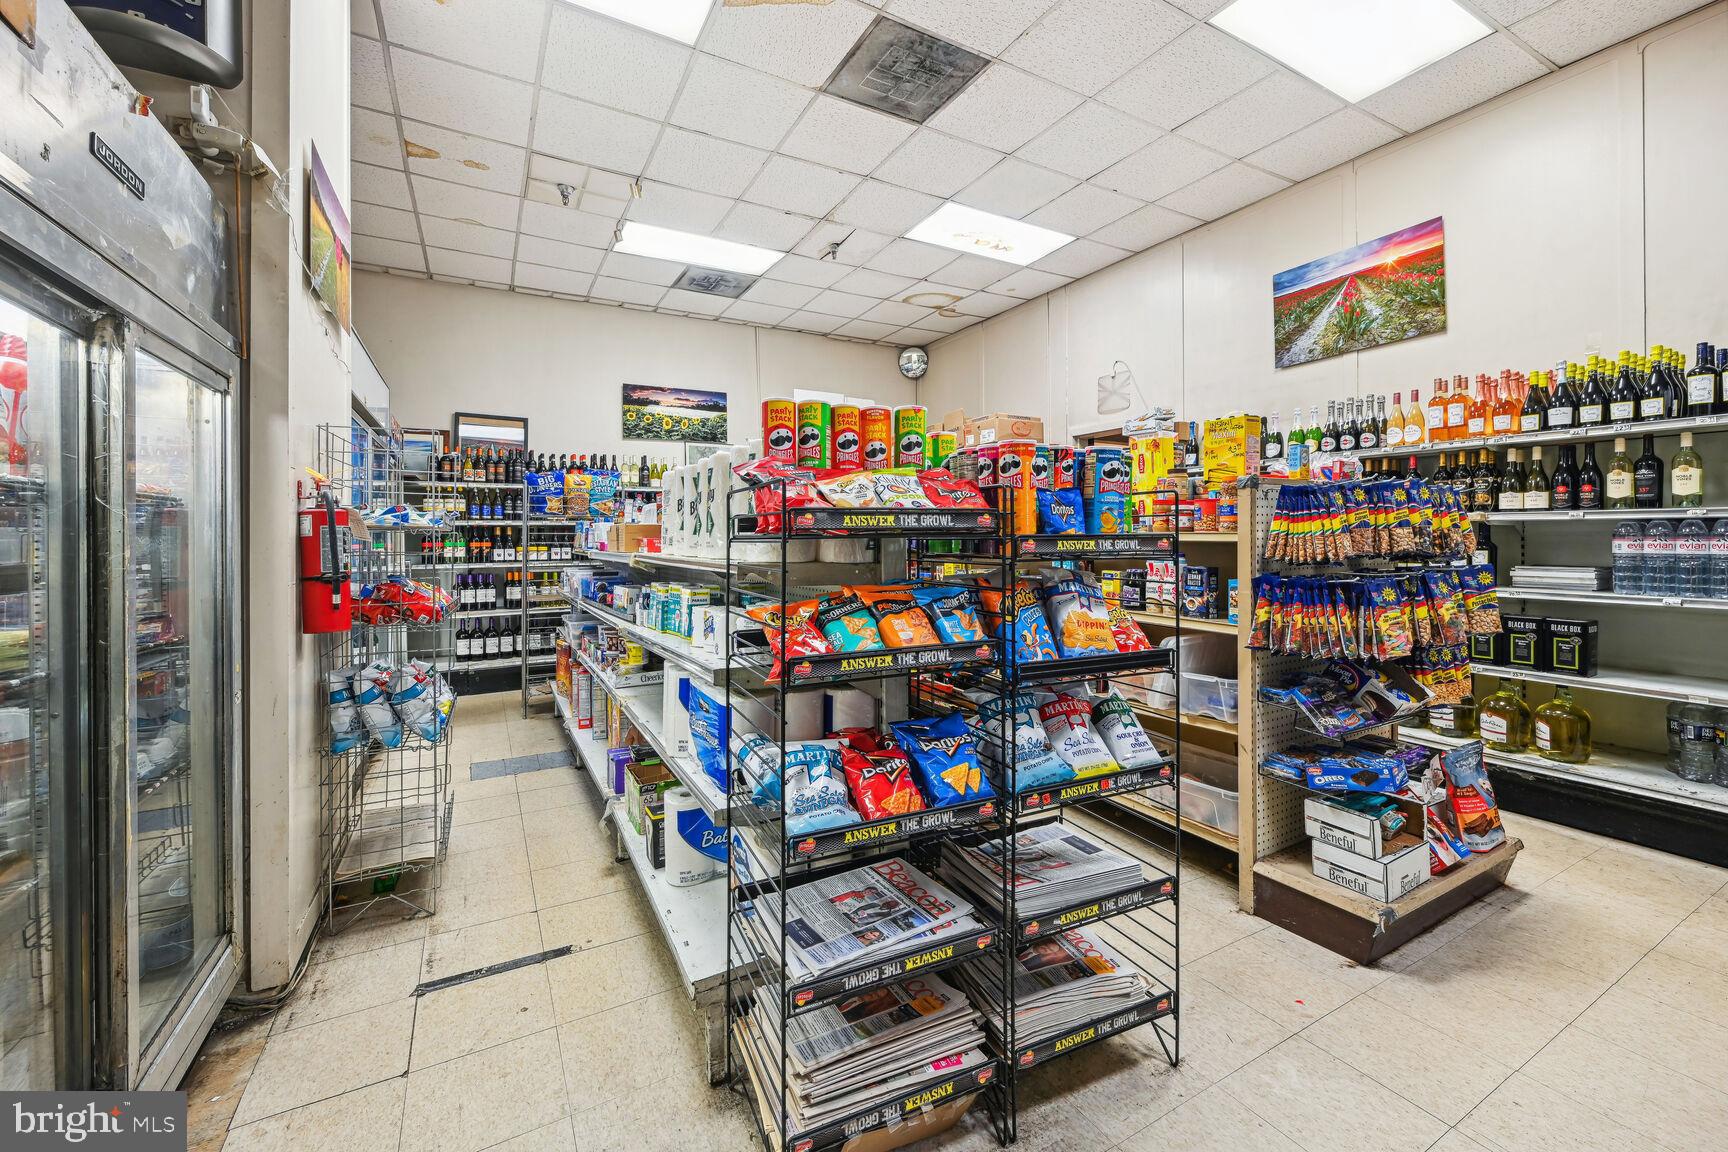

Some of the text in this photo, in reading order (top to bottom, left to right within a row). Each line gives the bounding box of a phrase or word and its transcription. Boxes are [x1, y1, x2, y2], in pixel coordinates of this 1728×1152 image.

[99, 143, 144, 192] JORDON
[769, 406, 792, 415] PARTY
[837, 412, 858, 420] PARTY
[769, 414, 792, 422] STACK
[837, 419, 858, 427] STACK
[901, 414, 922, 422] PARTY
[865, 423, 886, 431] PARTY
[866, 431, 886, 439] STACK
[836, 452, 859, 463] PRINGLES
[900, 453, 923, 465] PRINGLES
[1051, 503, 1075, 515] Doritos
[843, 514, 954, 526] ANSWER THE GROWL
[1057, 539, 1141, 550] ANSWER THE GROWL
[1058, 581, 1102, 598] MARTIN'S
[1022, 608, 1042, 626] PUFFS
[1077, 620, 1107, 630] DIPPIN'
[1551, 624, 1582, 633] BLACK BOX
[828, 632, 842, 641] SEA
[841, 650, 953, 671] ANSWER THE GROWL
[1329, 664, 1352, 678] Moon
[1341, 675, 1351, 684] Pie
[1045, 700, 1090, 716] MARTIN'S
[920, 733, 972, 752] Doritos
[1116, 732, 1131, 740] SOUR
[1064, 737, 1082, 752] Sea
[1131, 741, 1150, 749] ONION
[785, 750, 843, 766] MARTIN'S
[1072, 748, 1091, 758] POTATO
[1023, 756, 1053, 772] POTATO CHIPS
[1061, 781, 1099, 799] ANSWER
[1118, 772, 1142, 786] GROWL
[1315, 775, 1344, 784] OREO
[844, 811, 956, 844] ANSWER THE GROWL
[702, 830, 728, 848] Bat
[1320, 828, 1357, 851] Beneful
[1328, 868, 1369, 893] Beneful
[1401, 870, 1421, 894] Beneful
[875, 859, 952, 917] Beacon
[1059, 891, 1144, 925] ANSWER THE GROWL
[843, 945, 954, 989] ANSWER THE GROWL
[1055, 1010, 1140, 1052] ANSWER THE GROWL
[842, 1082, 954, 1135] ANSWER THE GROWL
